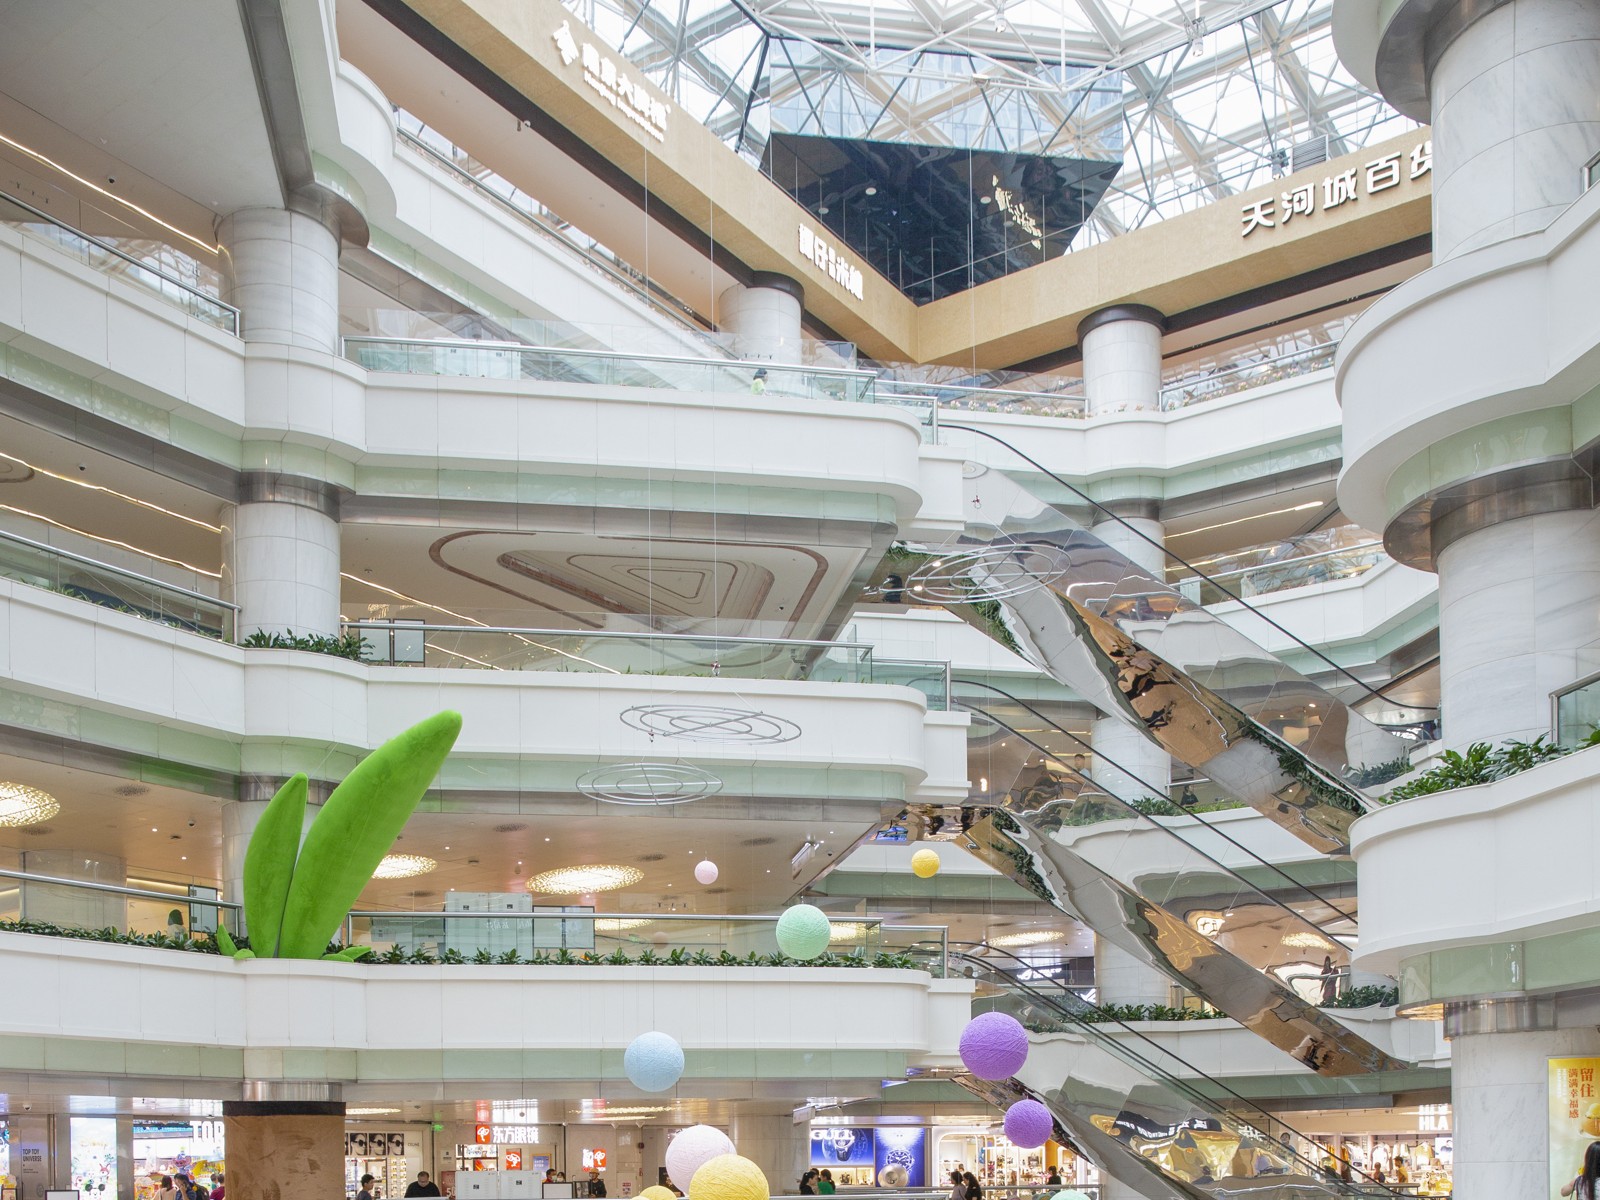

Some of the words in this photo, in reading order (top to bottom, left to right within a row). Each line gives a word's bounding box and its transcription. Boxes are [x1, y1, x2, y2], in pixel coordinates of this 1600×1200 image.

[1580, 1068, 1594, 1097] 留住
[1418, 1115, 1449, 1130] HLA
[493, 1126, 539, 1144] 东方眼镜
